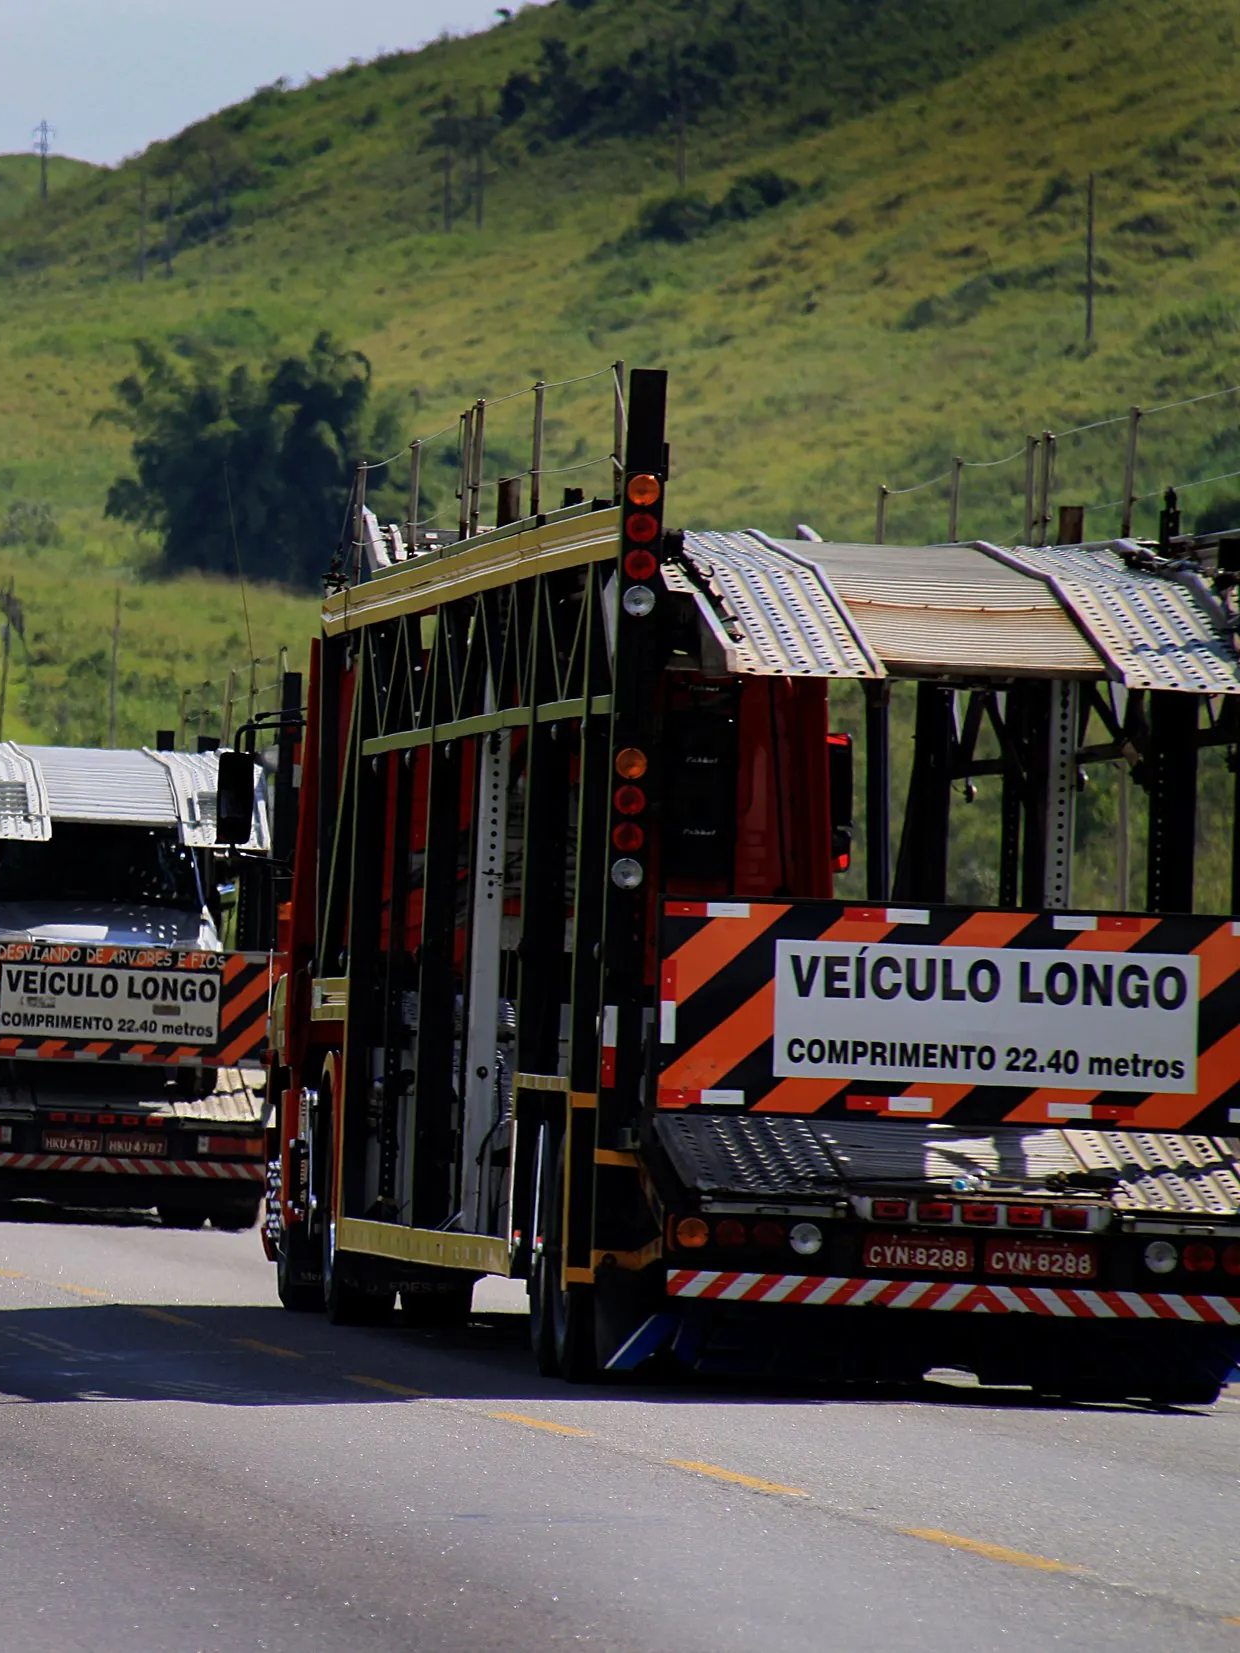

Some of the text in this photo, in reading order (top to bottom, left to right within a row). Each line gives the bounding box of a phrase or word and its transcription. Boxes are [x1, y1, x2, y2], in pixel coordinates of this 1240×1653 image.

[86, 949, 104, 963] DE
[108, 950, 173, 967] ARVORES
[178, 954, 186, 967] E
[190, 954, 227, 969] FIOS
[6, 966, 217, 1003] VEÍCULO LONGO
[790, 946, 1188, 1011] VEÍCULO LONGO
[1, 1013, 214, 1038] COMPRIMENTO 22.40 metros
[787, 1038, 1185, 1079] COMPRIMENTO 22.40 metros
